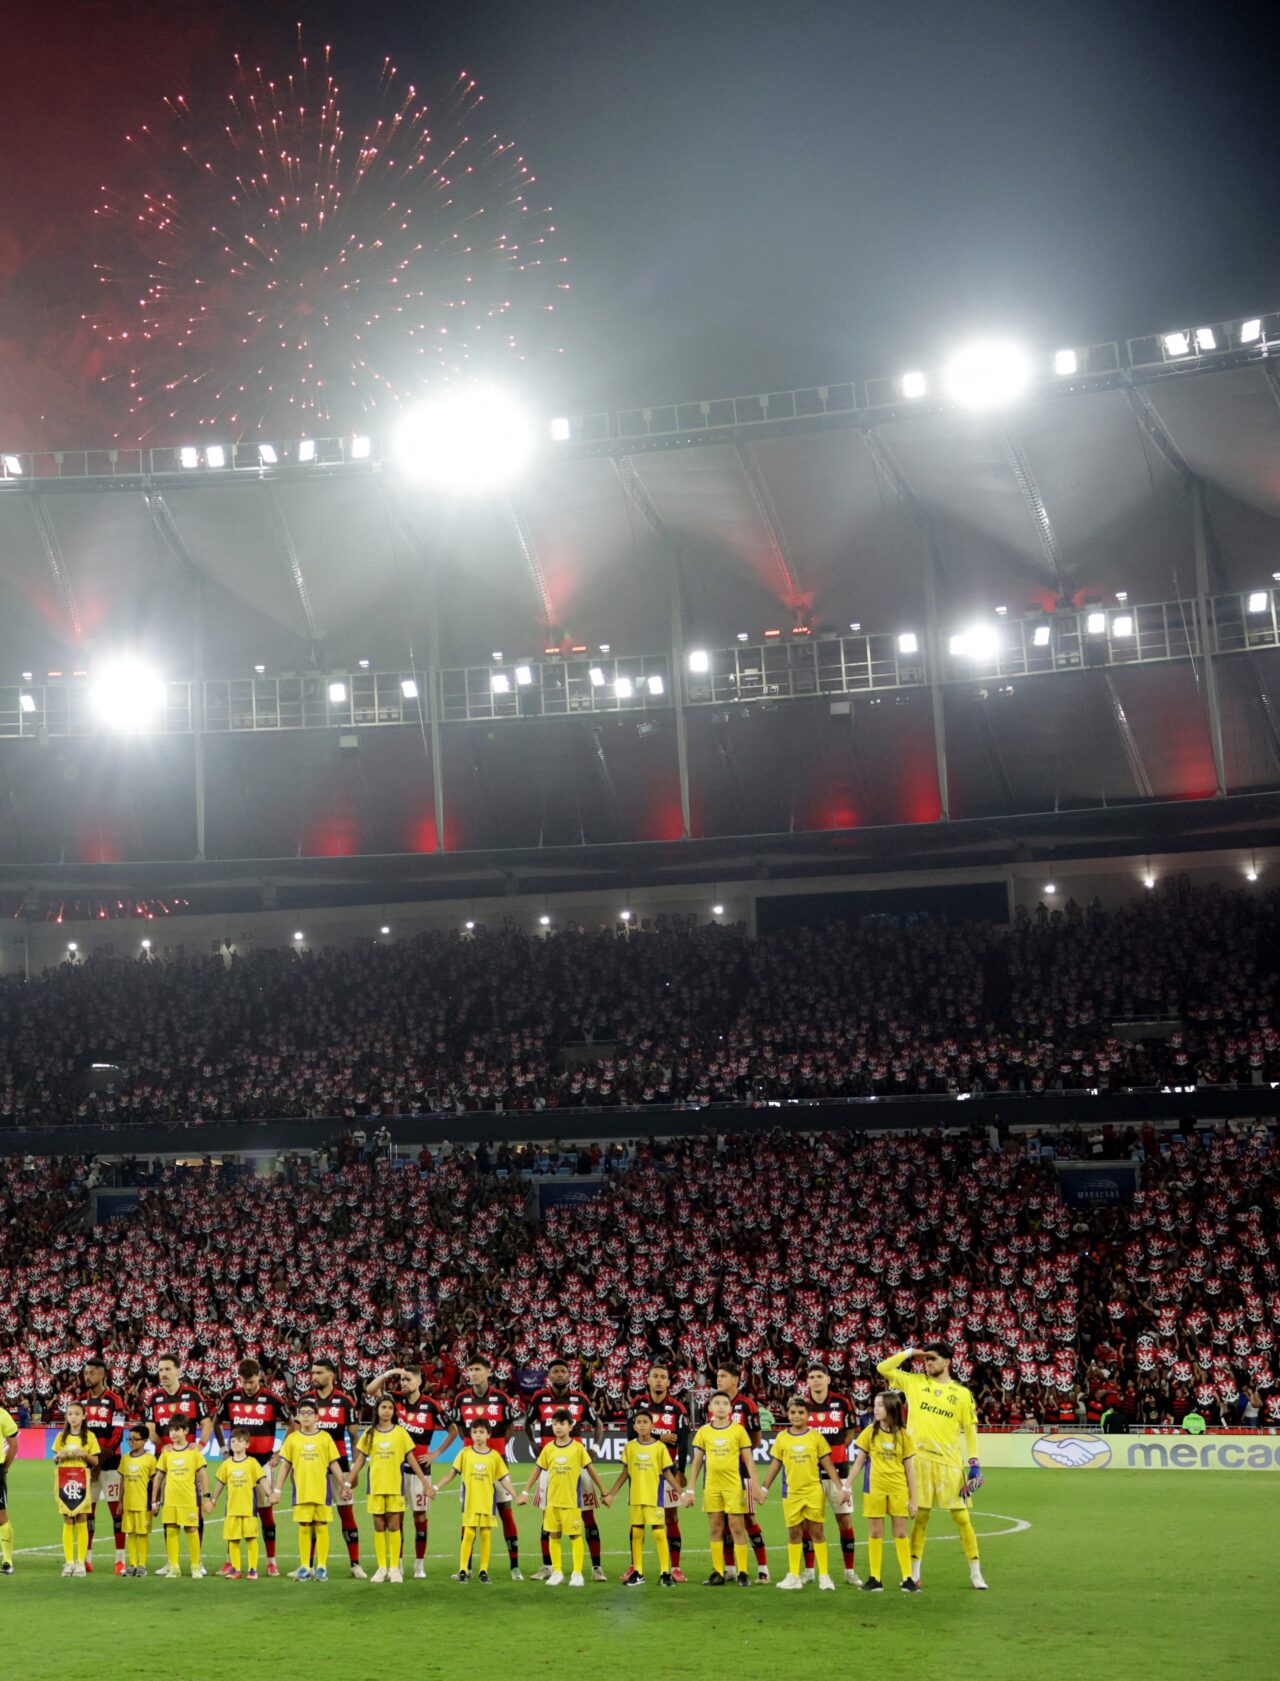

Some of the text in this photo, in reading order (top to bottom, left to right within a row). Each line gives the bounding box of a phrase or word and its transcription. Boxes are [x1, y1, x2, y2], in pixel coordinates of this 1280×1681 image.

[920, 1401, 954, 1419] Betano
[233, 1416, 264, 1426] Betano
[314, 1420, 338, 1429] etano
[108, 1484, 118, 1497] 27
[667, 1490, 678, 1503] 16
[583, 1493, 593, 1506] 22
